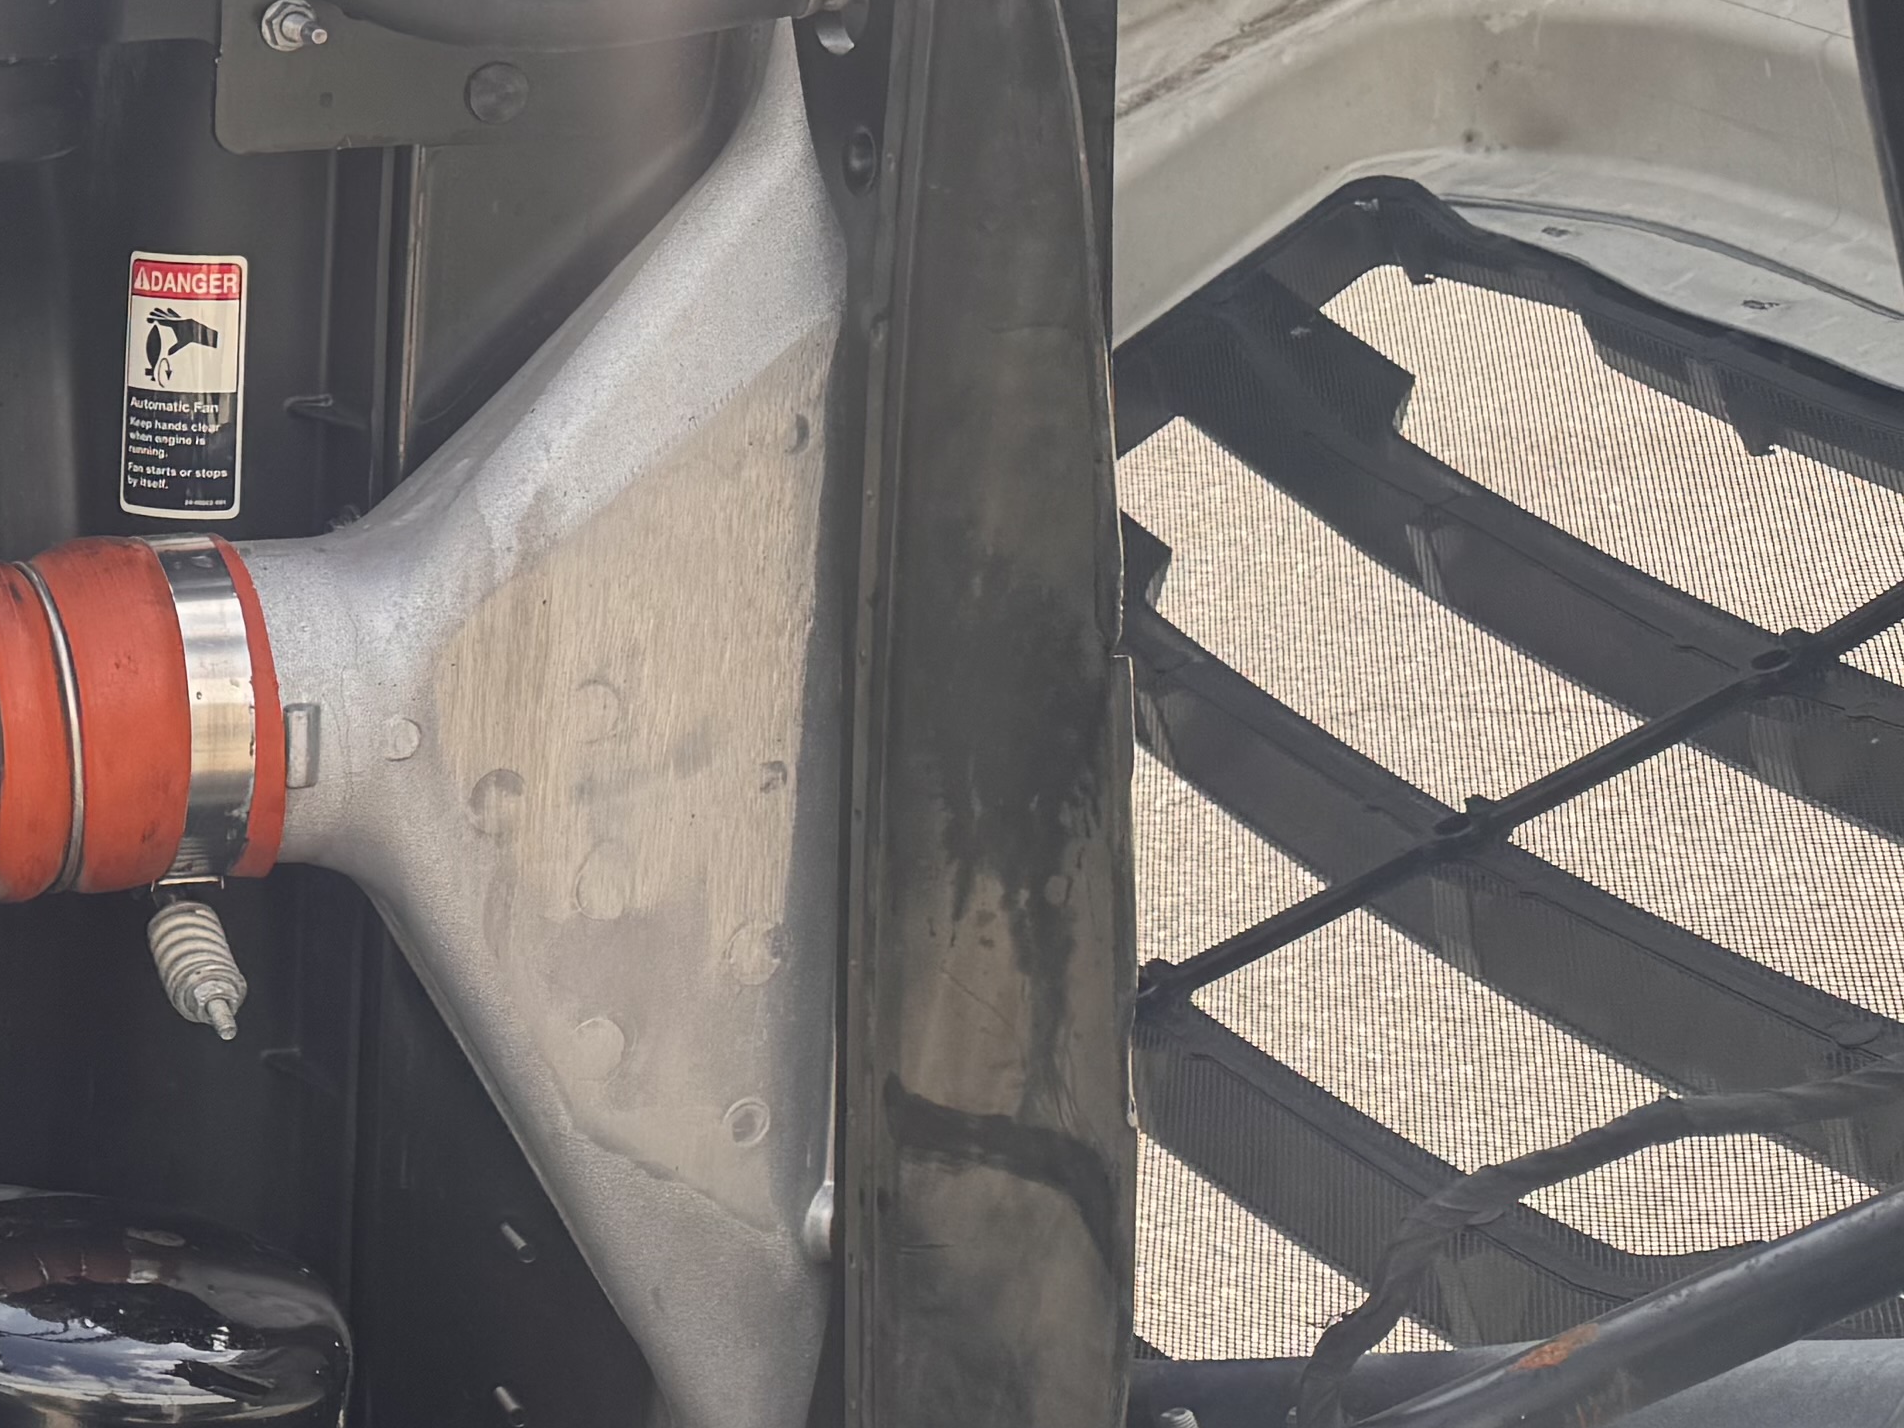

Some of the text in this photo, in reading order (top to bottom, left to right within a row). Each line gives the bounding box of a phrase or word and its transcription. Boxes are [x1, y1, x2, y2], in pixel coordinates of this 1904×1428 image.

[150, 272, 238, 295] DANGER
[130, 396, 219, 413] Automatic Fan
[129, 416, 221, 433] Keep hands clear
[154, 433, 192, 447] engine
[195, 435, 206, 446] is
[127, 462, 228, 480] Fan starts or stops
[127, 474, 169, 490] by itself.
